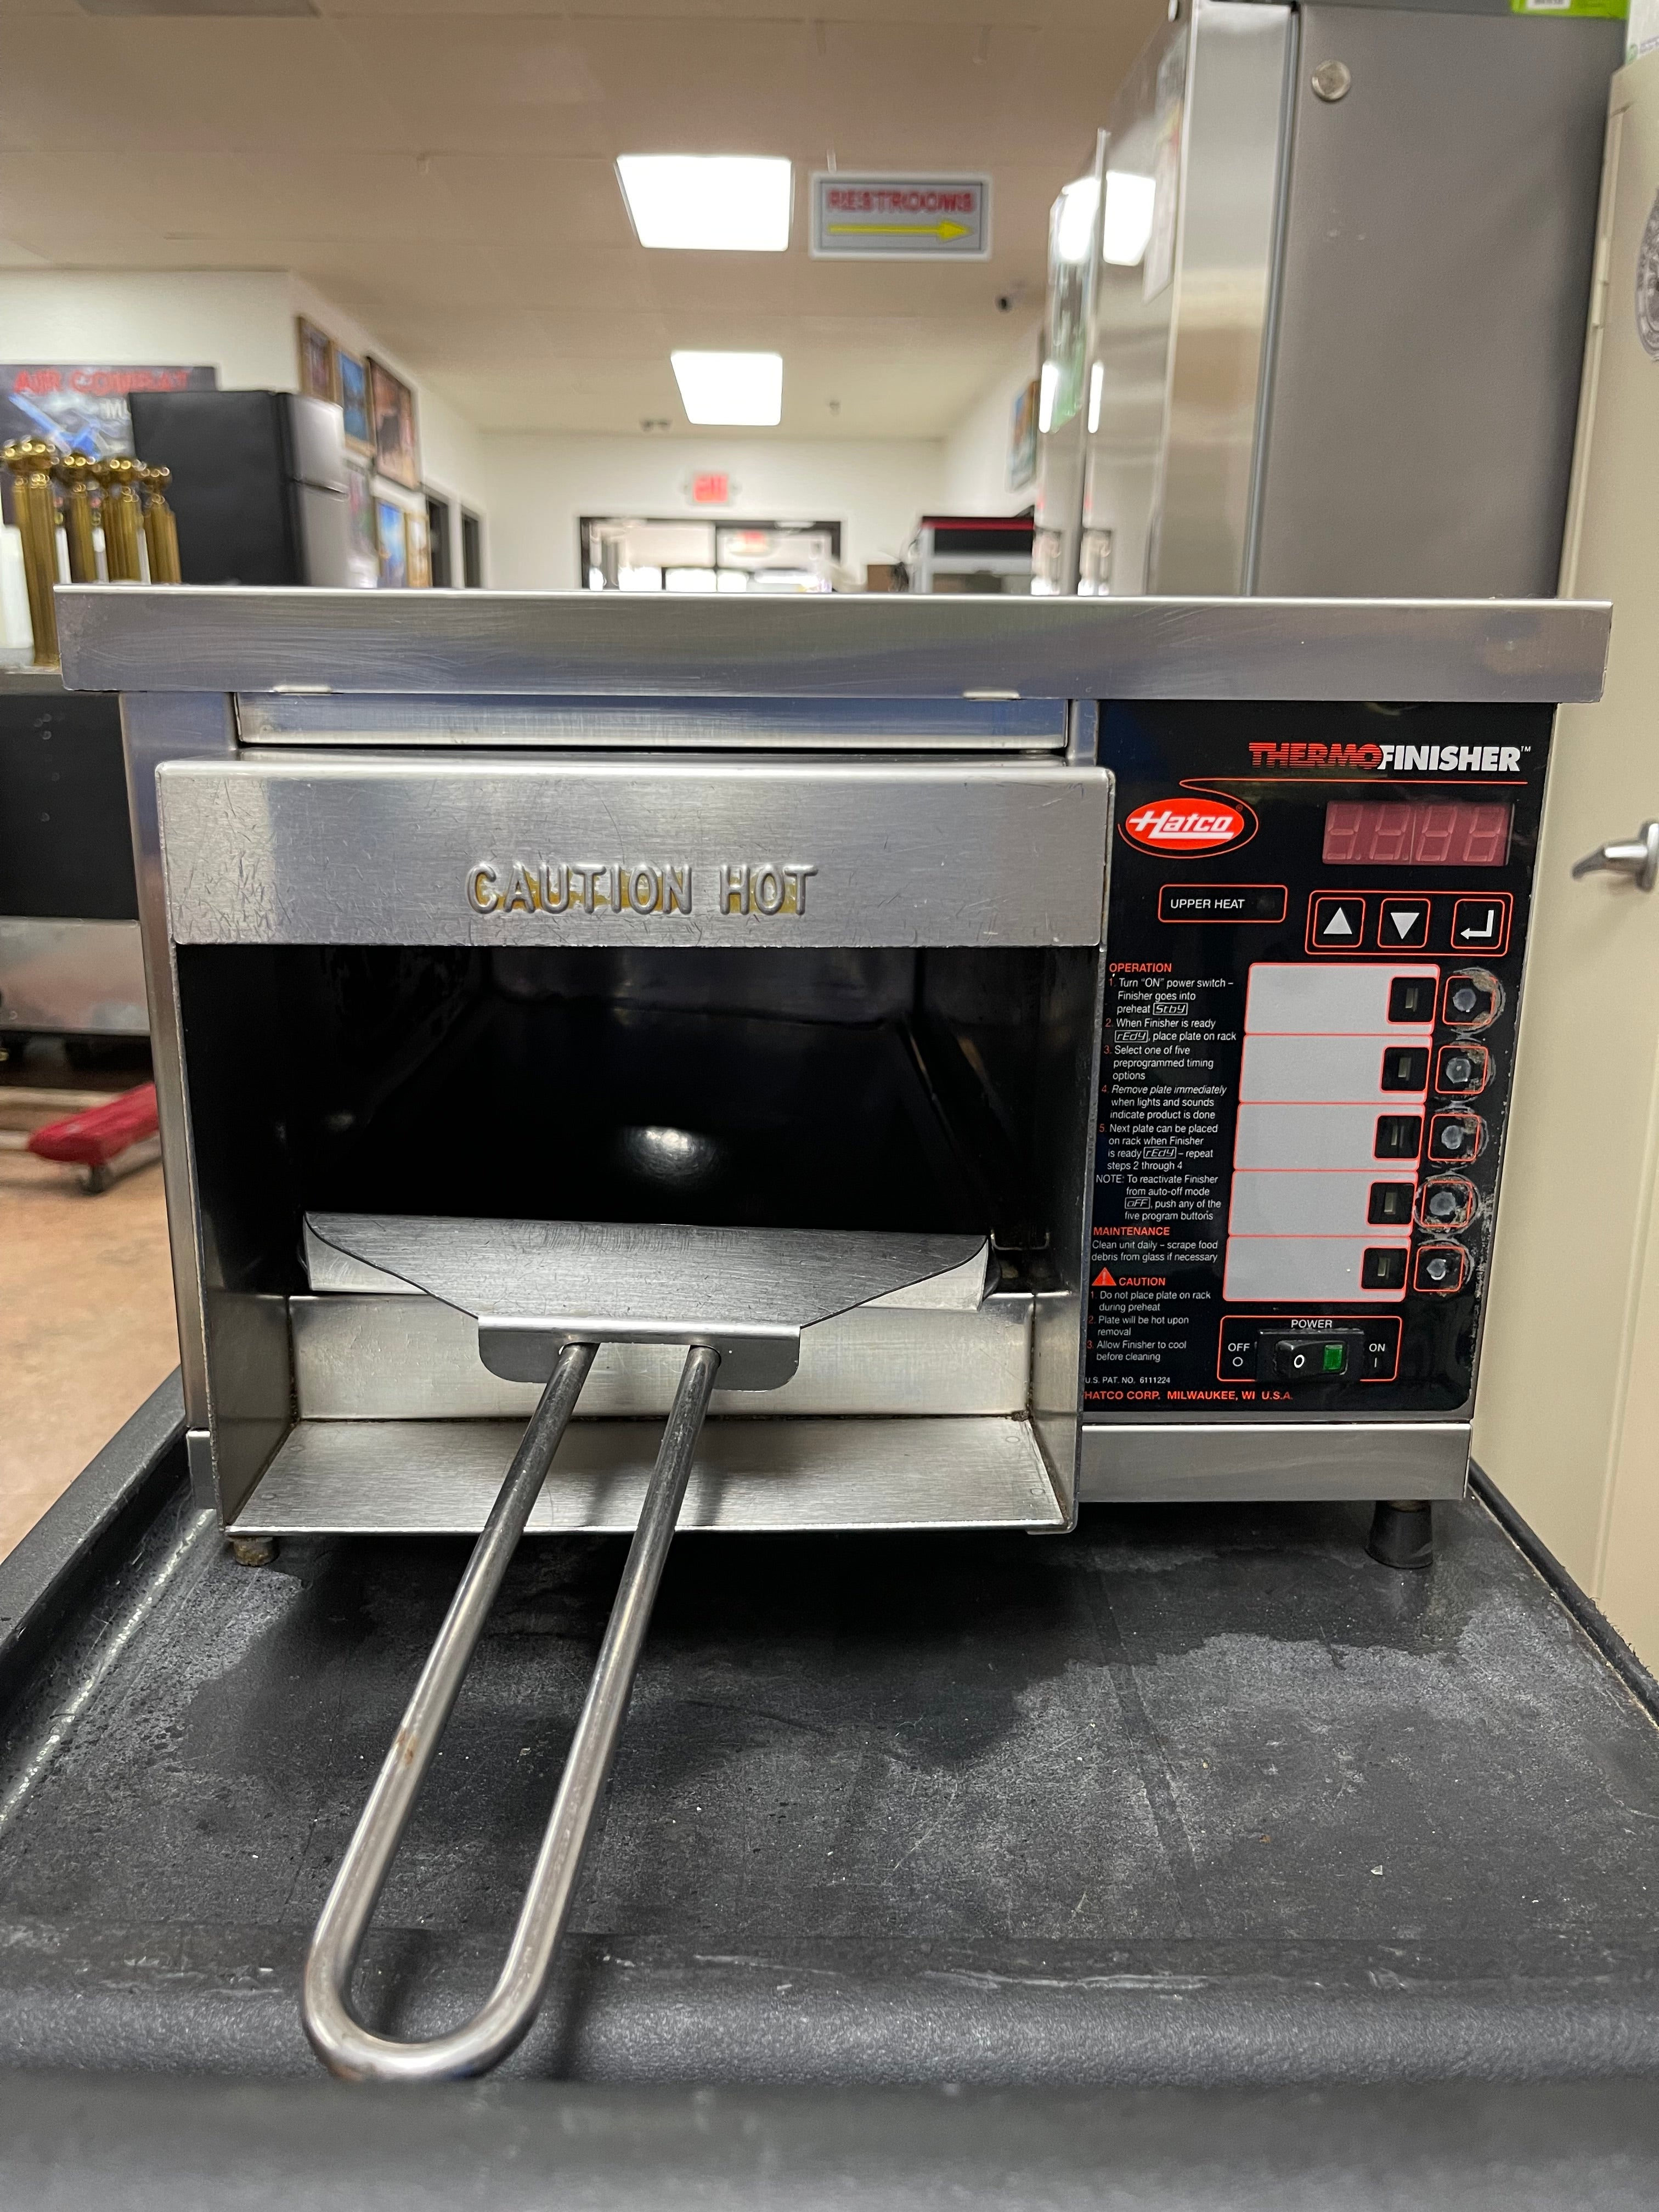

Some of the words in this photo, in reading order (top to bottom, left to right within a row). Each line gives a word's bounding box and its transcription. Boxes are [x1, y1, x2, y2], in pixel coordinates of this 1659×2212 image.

[828, 189, 974, 212] RESTROOMS
[466, 864, 692, 915] CAUTION
[719, 864, 818, 915] HOT
[1171, 899, 1211, 909] UPPER
[1215, 899, 1245, 909] HEAT
[1109, 963, 1172, 972] OPERATION
[1119, 978, 1138, 988] Turn
[1166, 979, 1195, 989] power
[1197, 979, 1226, 988] switch
[1118, 991, 1152, 1001] Finisher
[1155, 993, 1176, 1003] goes
[1180, 991, 1196, 1001] into
[1117, 1005, 1150, 1015] preheat
[1116, 1018, 1141, 1028] When
[1144, 1018, 1179, 1028] Finisher
[1182, 1018, 1188, 1028] is
[1191, 1019, 1216, 1029] ready
[1153, 1031, 1176, 1042] place
[1180, 1031, 1201, 1043] plate
[1204, 1032, 1215, 1041] on
[1217, 1031, 1236, 1041] rack
[1115, 1046, 1142, 1054] Select
[1163, 1046, 1172, 1054] of
[1174, 1046, 1190, 1054] five
[1114, 1059, 1184, 1069] preprogrammed
[1187, 1059, 1214, 1069] timing
[1113, 1072, 1146, 1081] options
[1111, 1085, 1148, 1094] Remove
[1150, 1085, 1172, 1095] plate
[1174, 1085, 1227, 1096] immediately
[1137, 1098, 1160, 1108] lights
[1163, 1098, 1180, 1106] and
[1182, 1098, 1214, 1107] sounds
[1110, 1111, 1144, 1119] indicate
[1147, 1111, 1181, 1120] product
[1193, 1111, 1215, 1119] done
[1109, 1124, 1130, 1132] Next
[1132, 1125, 1154, 1135] plate
[1188, 1125, 1218, 1135] placed
[1108, 1149, 1115, 1157] is
[1118, 1150, 1141, 1159] ready
[1186, 1150, 1213, 1159] repeat
[1107, 1162, 1131, 1172] steps
[1142, 1162, 1175, 1171] through
[1140, 1174, 1182, 1183] reactivate
[1184, 1175, 1218, 1183] Finisher
[1126, 1187, 1146, 1195] from
[1148, 1187, 1183, 1196] auto-off
[1185, 1187, 1209, 1196] mode
[1155, 1200, 1176, 1209] push
[1178, 1200, 1194, 1210] any
[1197, 1199, 1205, 1208] of
[1207, 1199, 1221, 1208] the
[1125, 1212, 1139, 1220] five
[1142, 1212, 1178, 1222] program
[1181, 1211, 1214, 1220] buttons
[1093, 1227, 1171, 1235] MAINTENANCE
[1092, 1240, 1117, 1249] Clean
[1119, 1240, 1135, 1249] unit
[1138, 1240, 1158, 1251] daily
[1167, 1242, 1196, 1251] scrape
[1199, 1240, 1218, 1249] food
[1142, 1253, 1164, 1263] glass
[1167, 1252, 1172, 1261] if
[1174, 1254, 1218, 1263] necessary
[1119, 1277, 1166, 1286] CAUTION
[1131, 1291, 1153, 1301] place
[1156, 1291, 1177, 1301] plate
[1193, 1291, 1210, 1299] rack
[1099, 1304, 1126, 1313] during
[1128, 1304, 1160, 1312] preheat
[1098, 1316, 1120, 1324] Plate
[1138, 1316, 1149, 1324] be
[1152, 1316, 1165, 1324] hot
[1167, 1317, 1189, 1325] upon
[1291, 1319, 1332, 1328] POWER
[1097, 1328, 1131, 1336] removal
[1228, 1343, 1250, 1352] OFF
[1369, 1343, 1385, 1352] ON
[1126, 1353, 1161, 1363] cleaning
[1084, 1391, 1124, 1400] HATCO
[1127, 1391, 1160, 1400] CORP.
[1167, 1391, 1238, 1401] MILWAUKEE,
[1242, 1391, 1255, 1400] WI
[1262, 1392, 1293, 1400] U.S.A.
